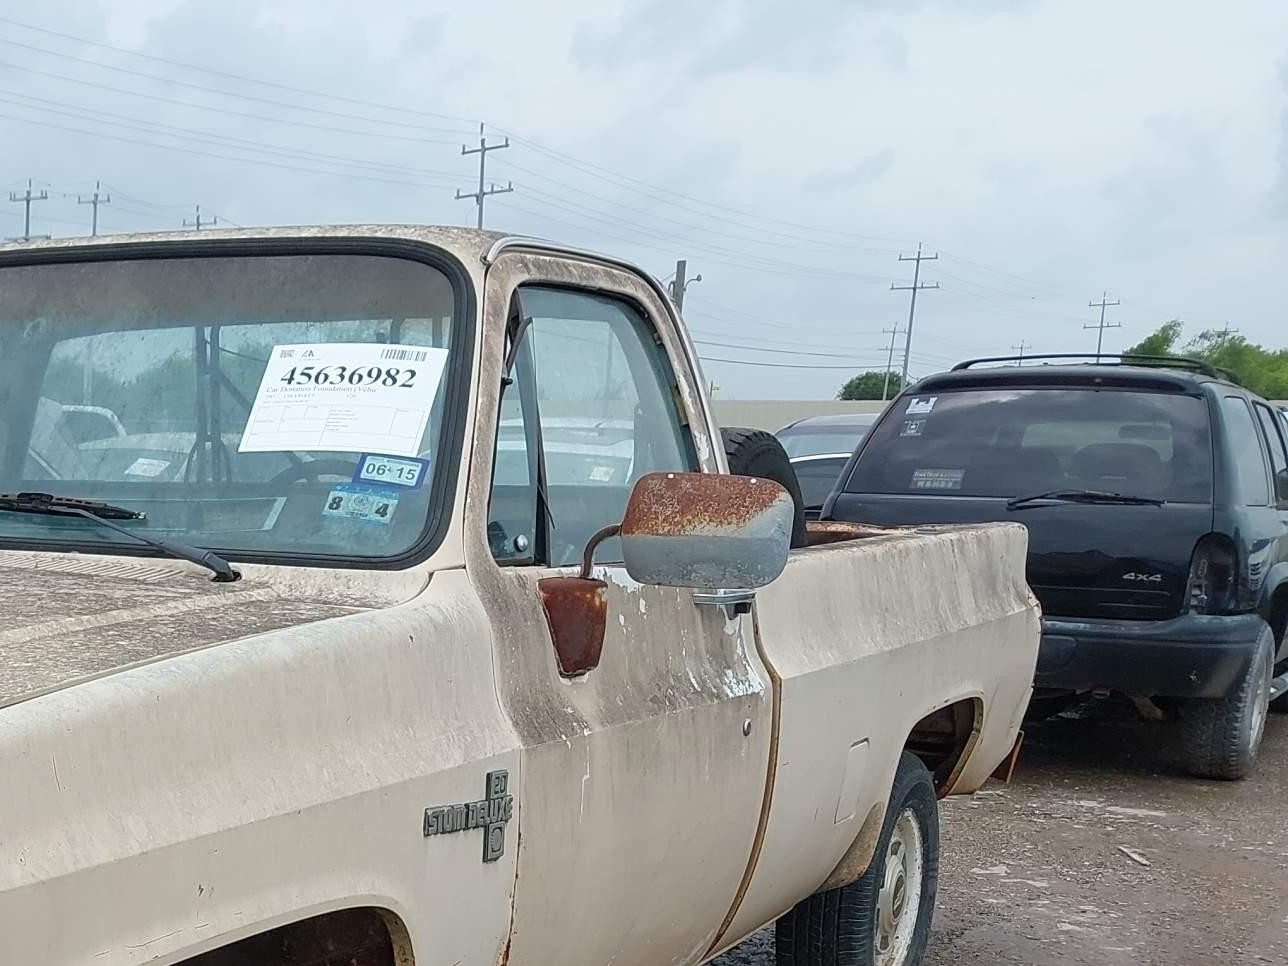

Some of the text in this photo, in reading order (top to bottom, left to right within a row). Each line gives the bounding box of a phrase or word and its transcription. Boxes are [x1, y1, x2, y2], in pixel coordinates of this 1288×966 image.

[280, 366, 417, 388] 45636982
[365, 463, 417, 480] 06 15
[328, 496, 343, 510] 8
[374, 503, 389, 517] 4
[1122, 572, 1162, 581] 4x4
[493, 774, 507, 795] 20
